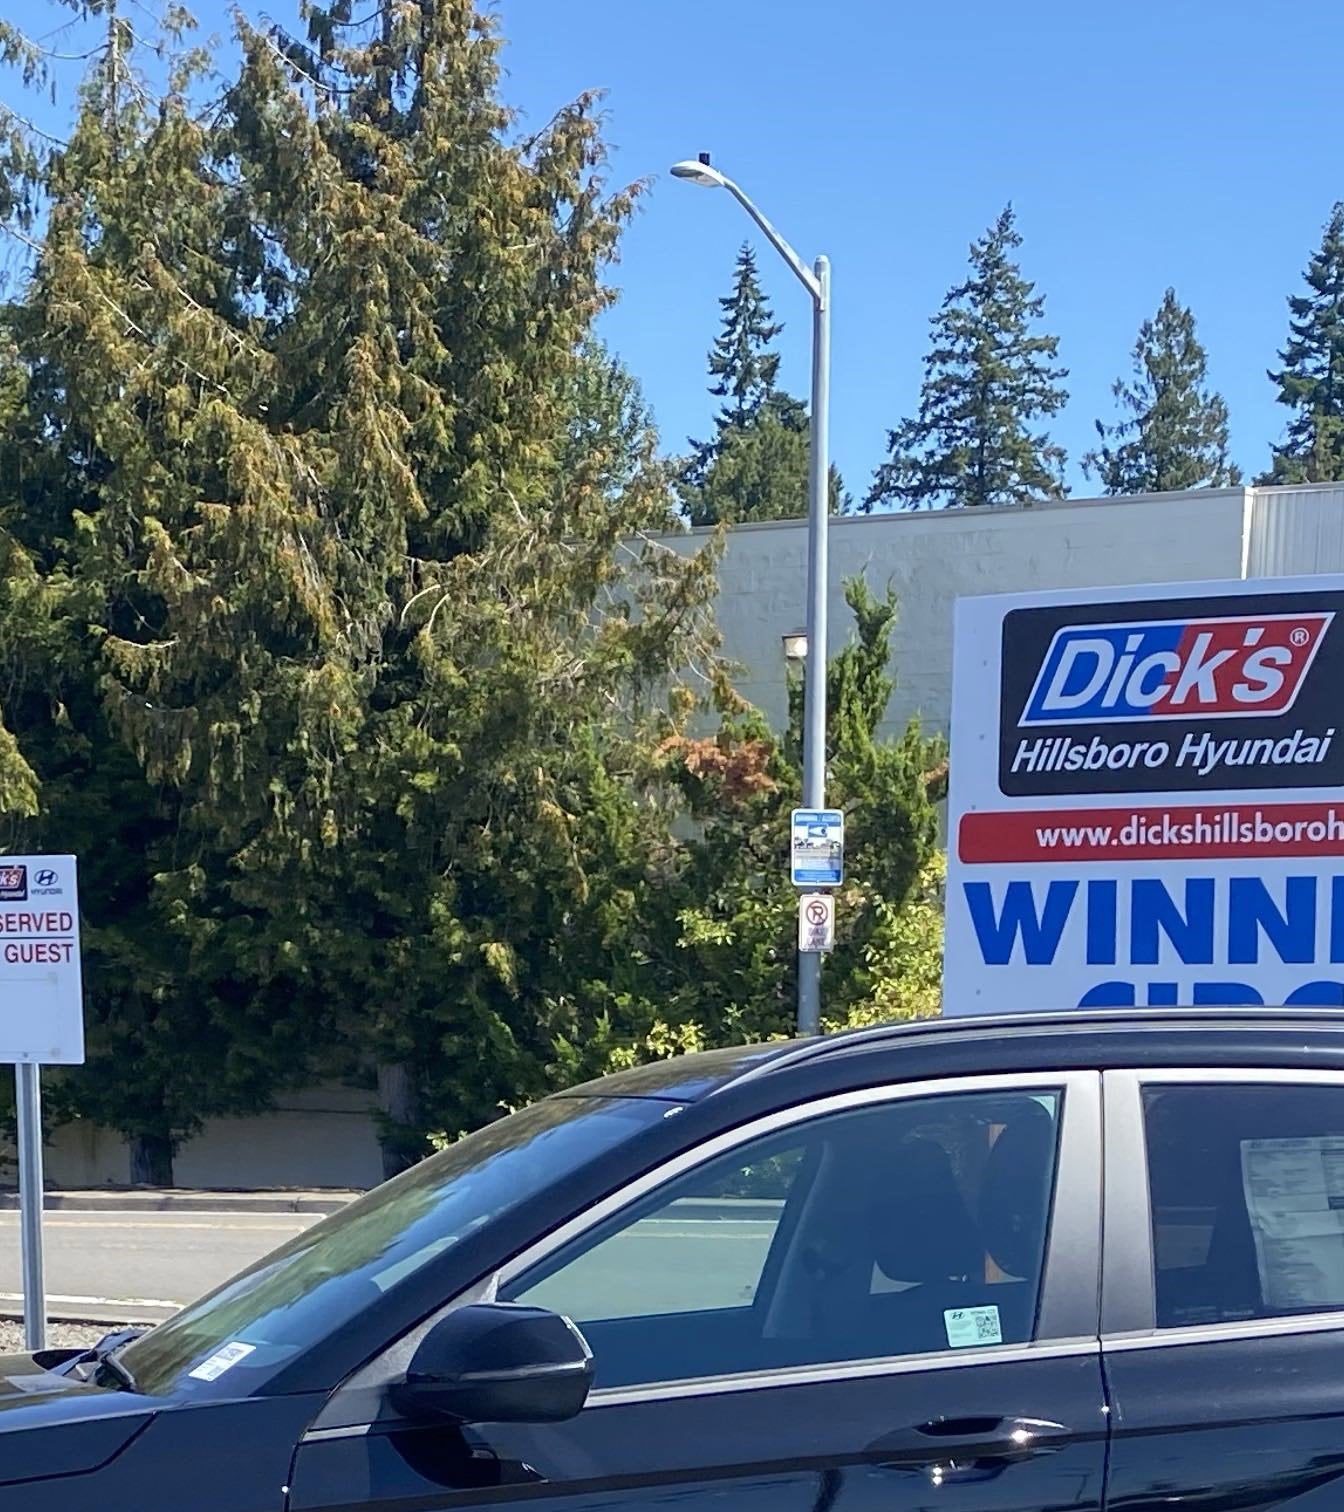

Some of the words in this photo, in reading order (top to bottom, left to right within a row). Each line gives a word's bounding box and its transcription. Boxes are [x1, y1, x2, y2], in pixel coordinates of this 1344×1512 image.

[1041, 628, 1293, 711] Dick's
[1010, 736, 1169, 773] Hillsboro
[1175, 728, 1336, 775] Hyundai
[5, 943, 74, 964] GUEST
